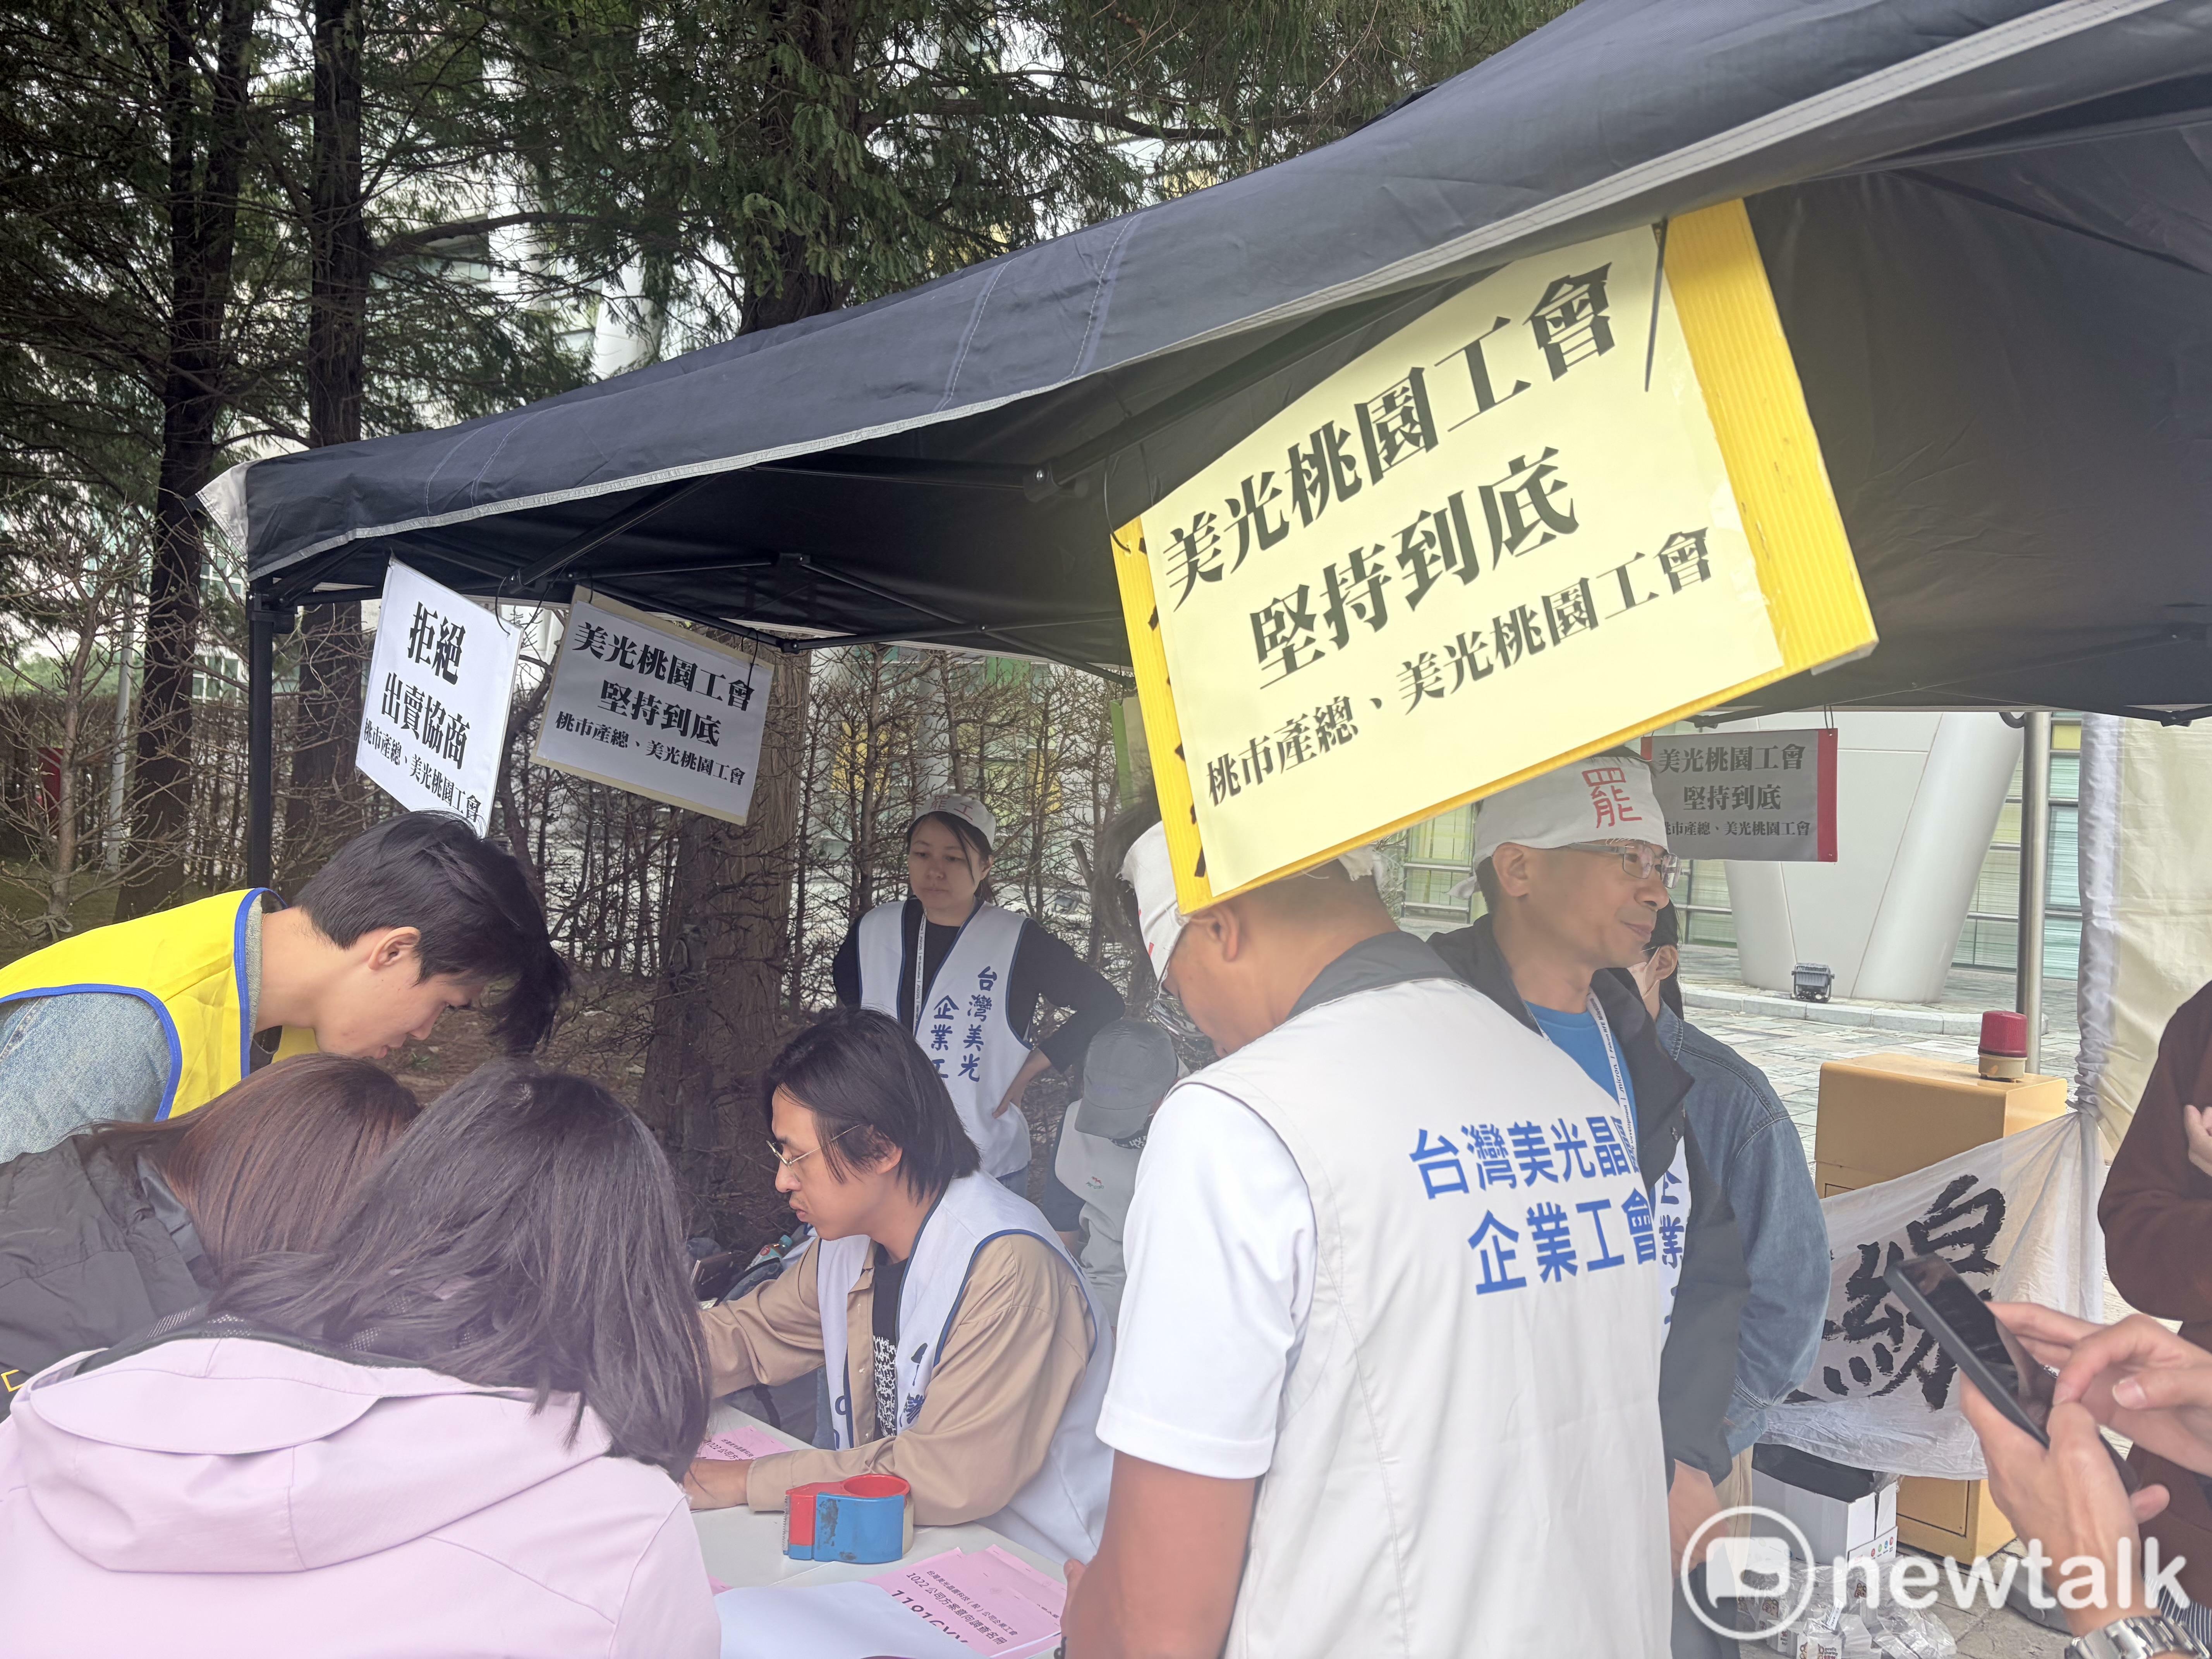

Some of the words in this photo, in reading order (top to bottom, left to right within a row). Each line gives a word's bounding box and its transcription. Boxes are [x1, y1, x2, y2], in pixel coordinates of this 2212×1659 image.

[1163, 262, 1616, 612] 美光桃園工會
[1250, 446, 1579, 690] 堅持到底
[407, 601, 465, 685] 拒絕
[572, 622, 755, 711] 美光桃園工會
[1205, 527, 1713, 808] 桃市產總、美光桃園工會
[381, 673, 470, 770] 出賣協商
[555, 711, 746, 785] 桃市產總、美光桃園工會
[597, 680, 720, 747] 堅持到底
[364, 717, 481, 823] 桃市產總、美光桃園工會
[1581, 767, 1642, 829] 罷
[1658, 743, 1806, 774] 美光桃園工會
[1683, 784, 1781, 811] 堅持到底
[958, 966, 997, 1082] 台灣美光
[1614, 1064, 1625, 1093] micron
[1467, 1187, 1657, 1295] 企業工會
[907, 1573, 929, 1588] 1022
